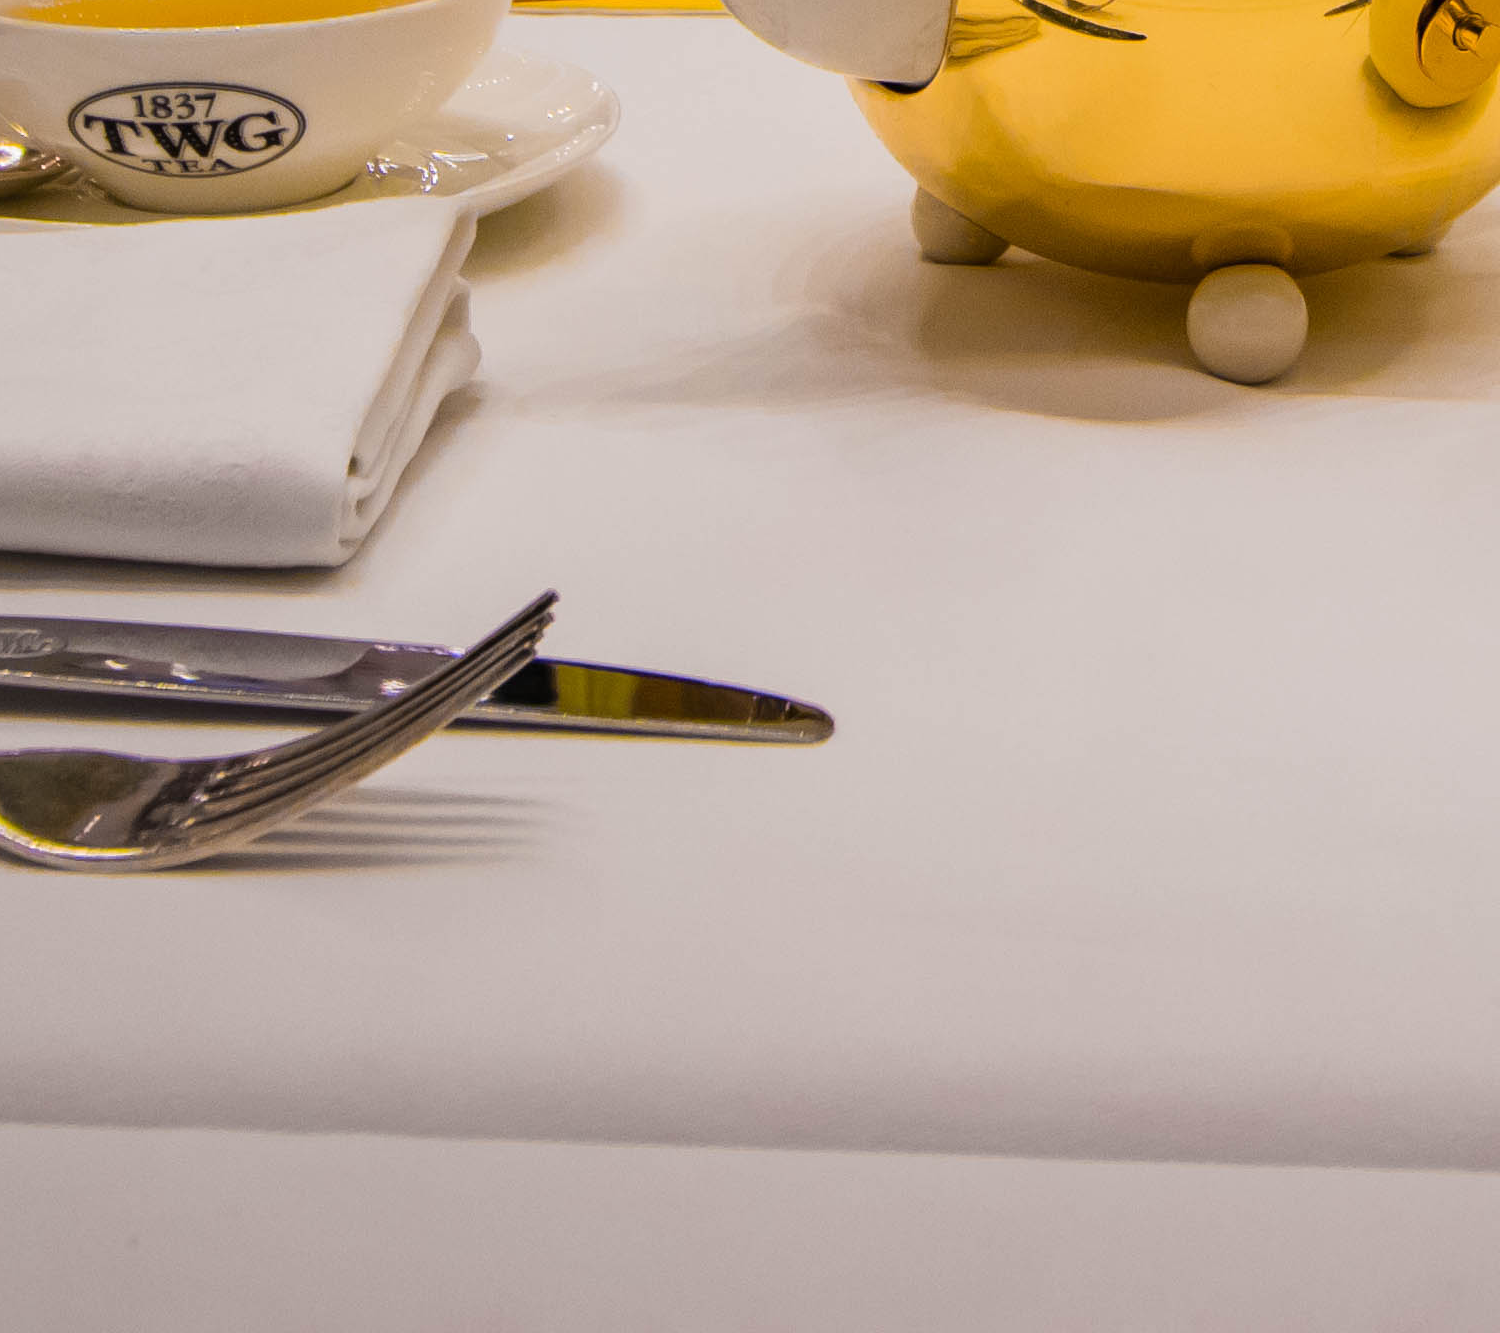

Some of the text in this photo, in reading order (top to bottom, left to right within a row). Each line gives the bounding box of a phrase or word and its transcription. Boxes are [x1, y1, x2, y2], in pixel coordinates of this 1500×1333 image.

[131, 93, 217, 120] 1837
[83, 110, 291, 160] TWG
[142, 158, 242, 174] TEA
